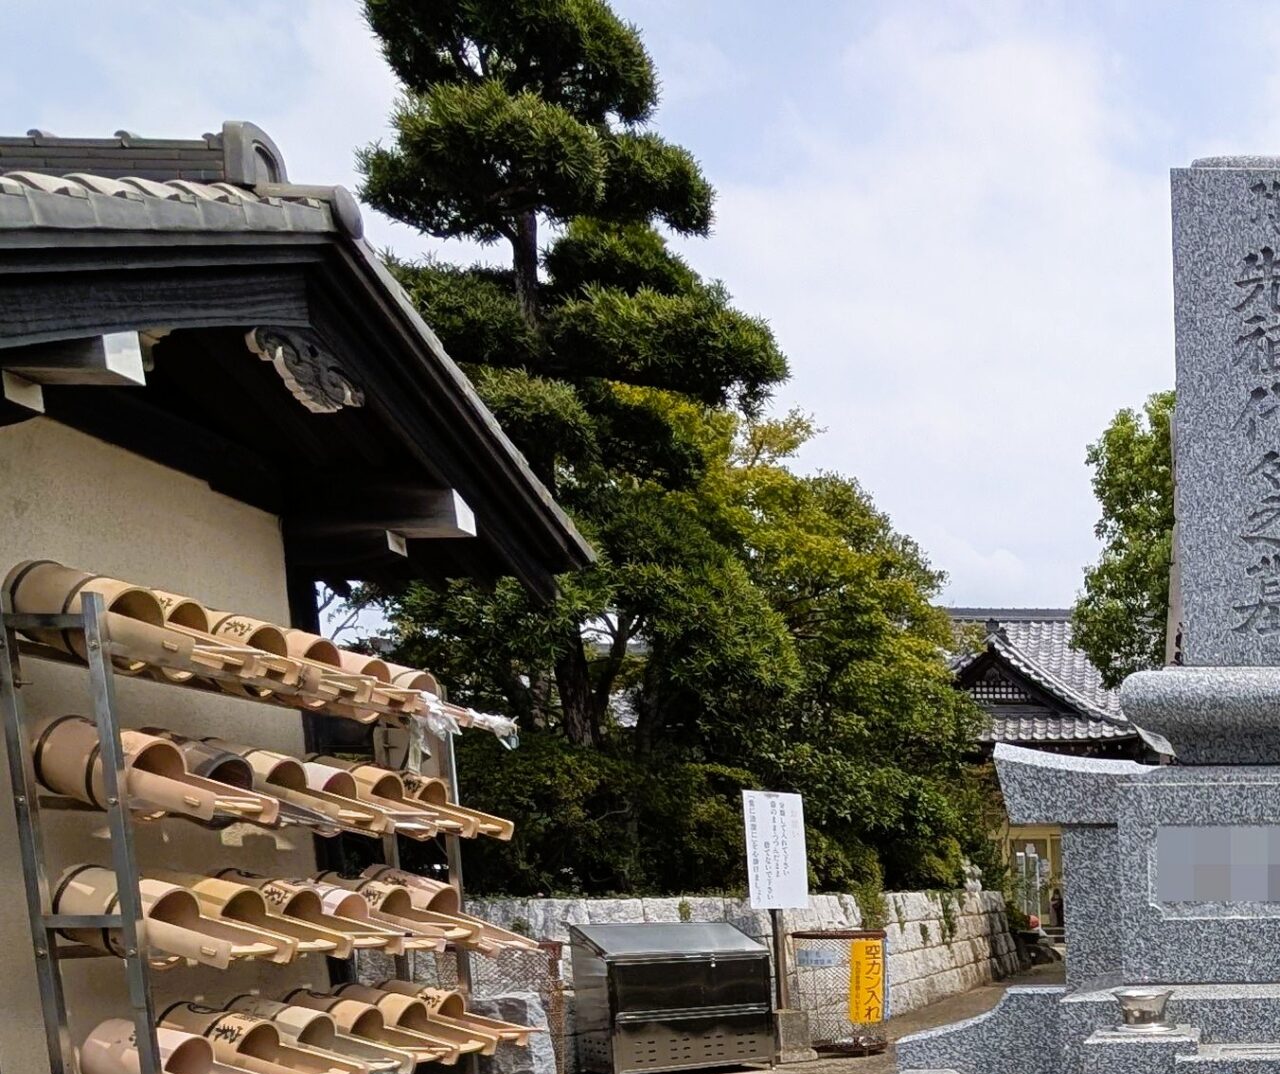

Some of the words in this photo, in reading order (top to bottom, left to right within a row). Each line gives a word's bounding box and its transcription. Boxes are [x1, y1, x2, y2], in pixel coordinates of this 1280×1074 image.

[863, 944, 882, 1021] 空カン入れ
